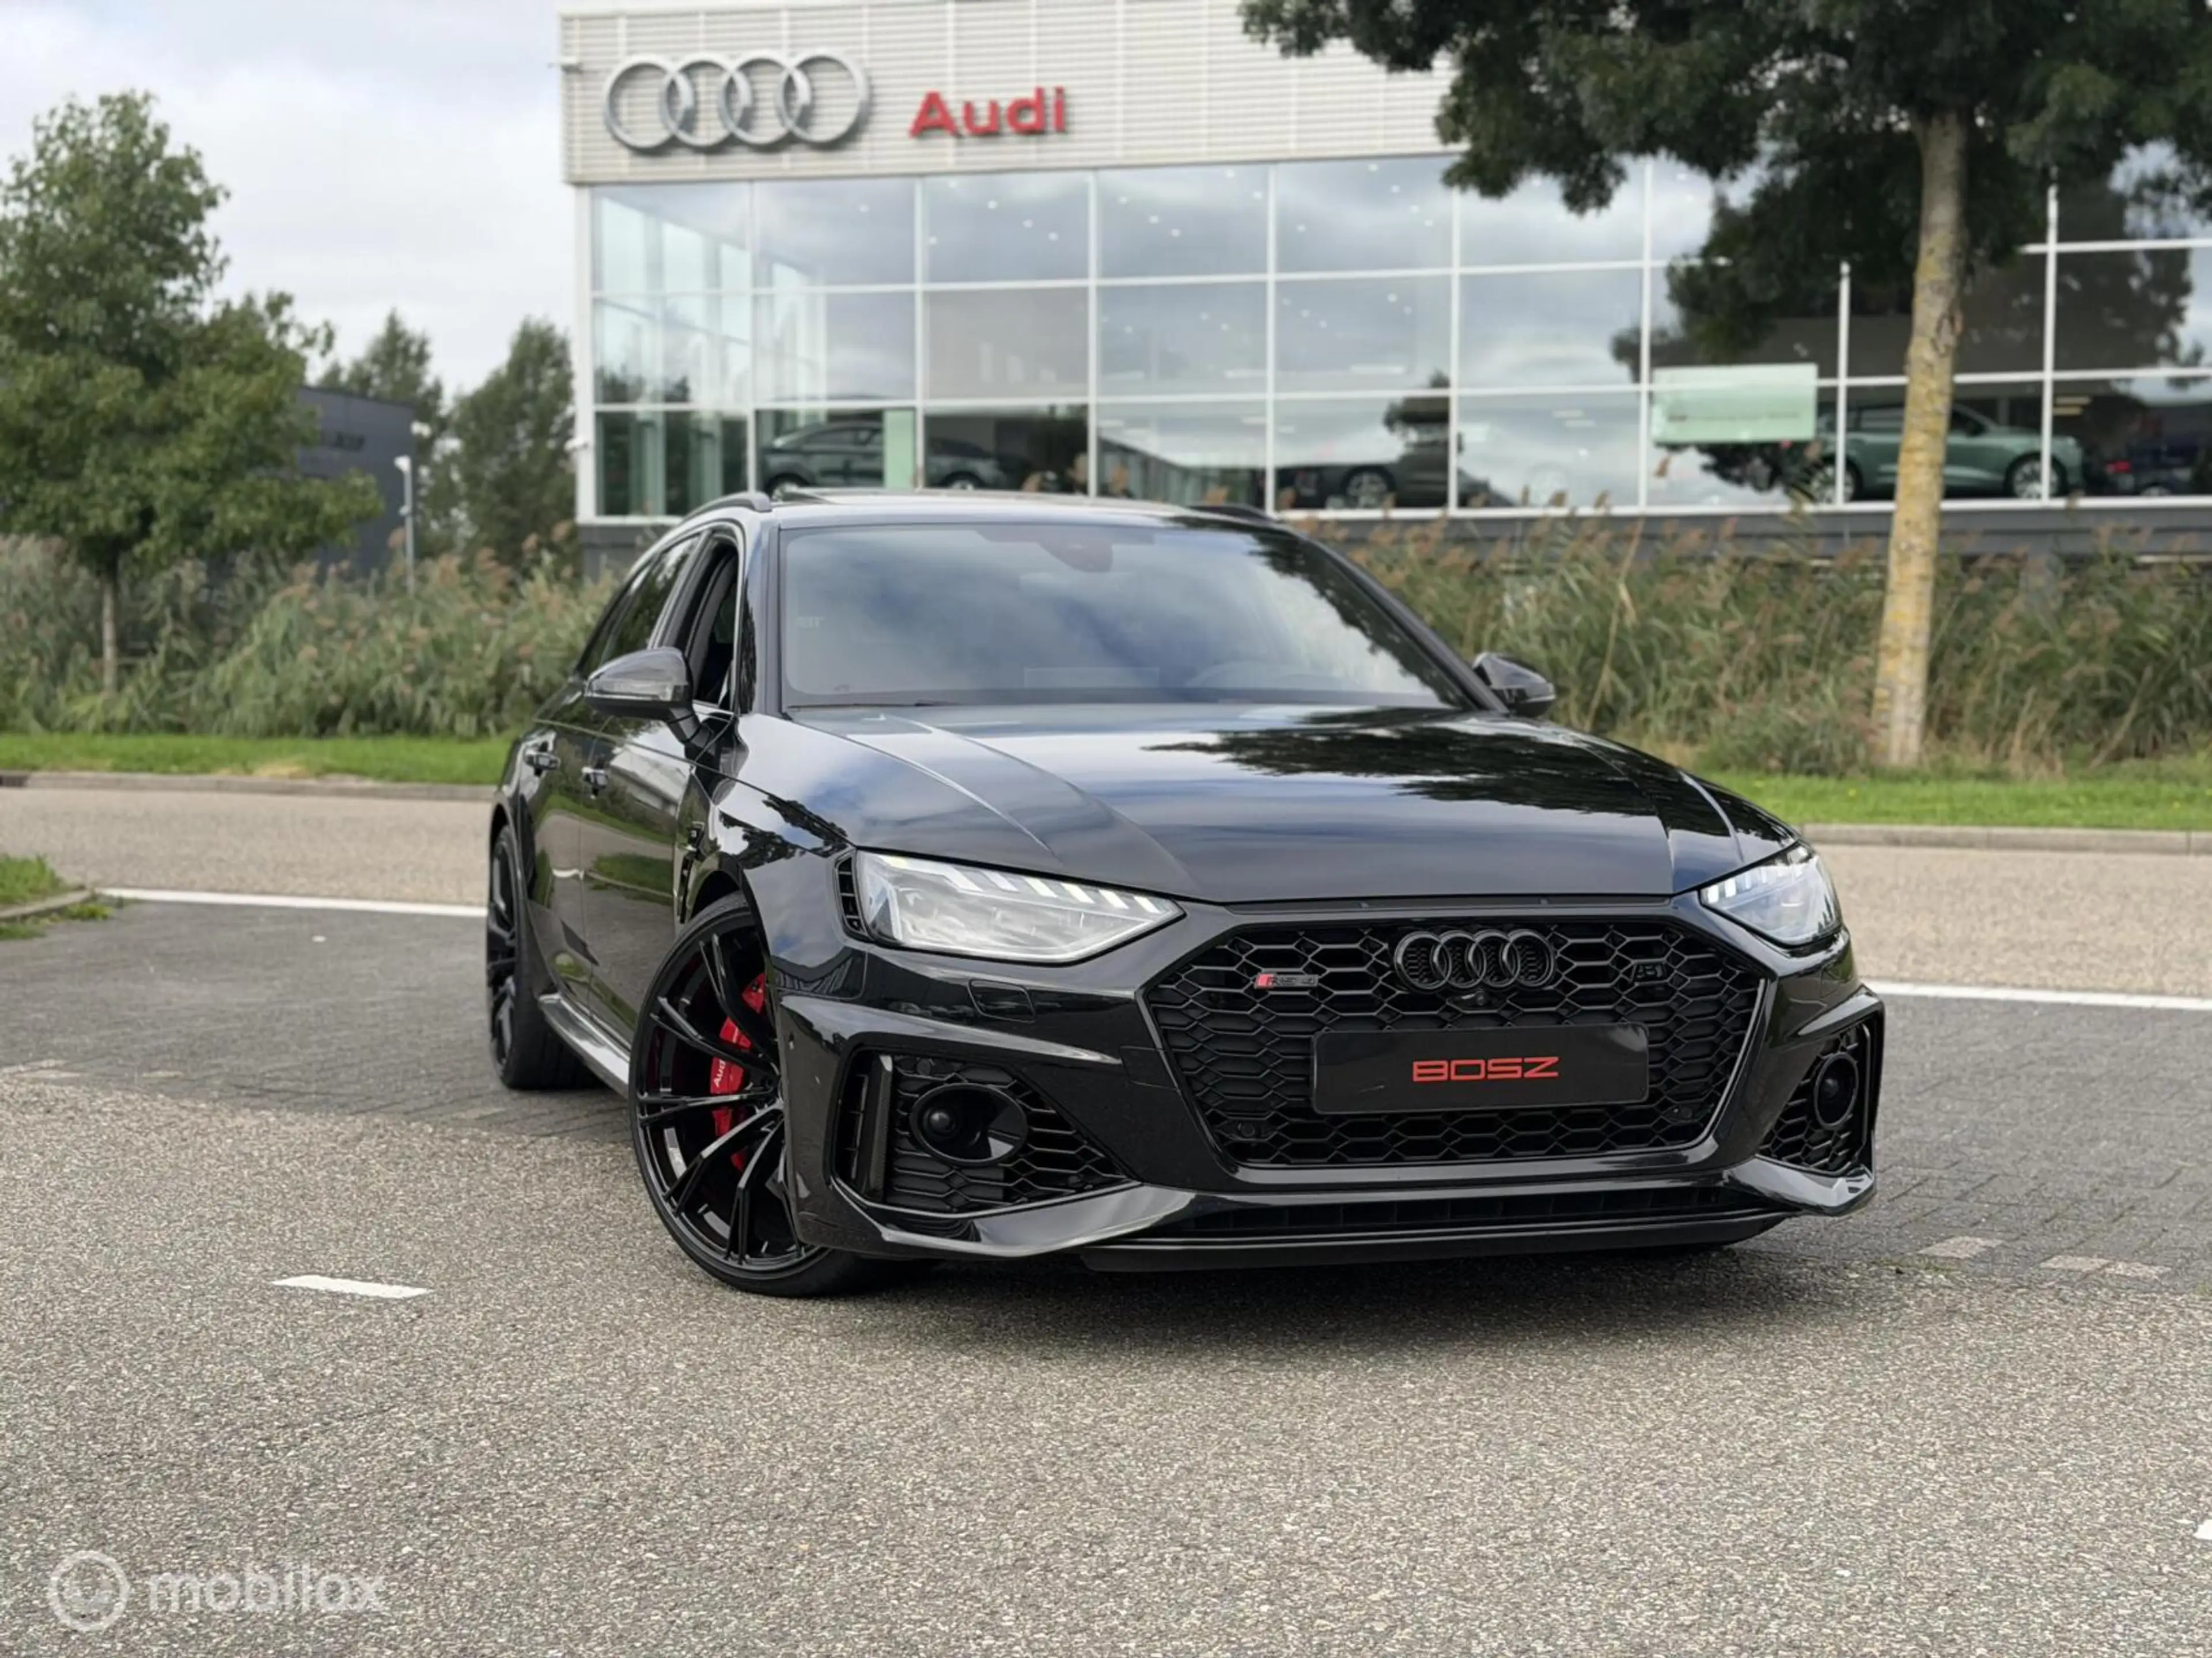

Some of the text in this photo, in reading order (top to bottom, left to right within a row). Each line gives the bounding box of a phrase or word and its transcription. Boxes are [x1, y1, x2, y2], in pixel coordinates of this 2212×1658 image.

[910, 85, 1065, 136] Audi
[714, 1058, 726, 1088] Aud
[1413, 1056, 1559, 1082] BOSZ
